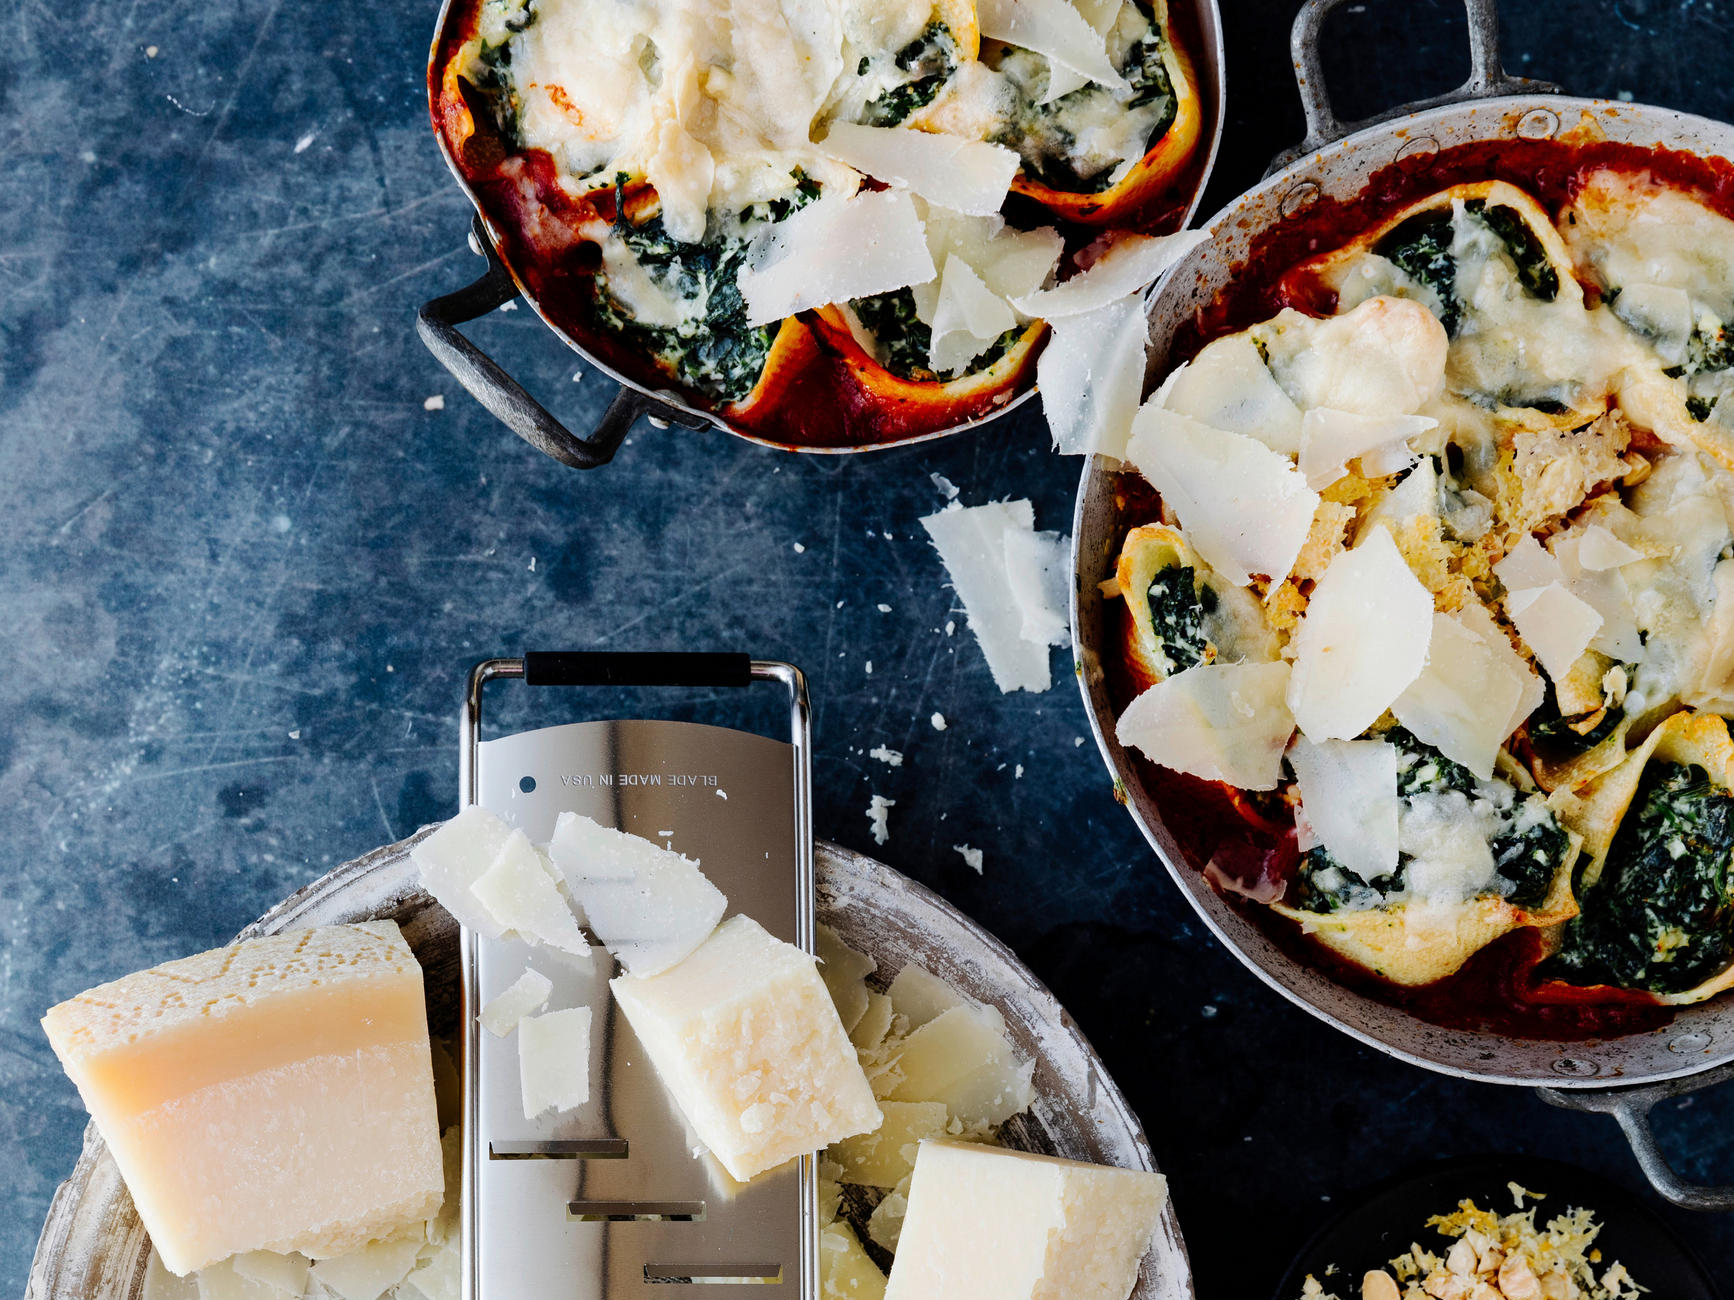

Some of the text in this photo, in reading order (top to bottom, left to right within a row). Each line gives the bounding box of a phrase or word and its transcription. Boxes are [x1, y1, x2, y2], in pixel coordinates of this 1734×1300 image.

[561, 774, 718, 787] BLADE MADE IN USA
